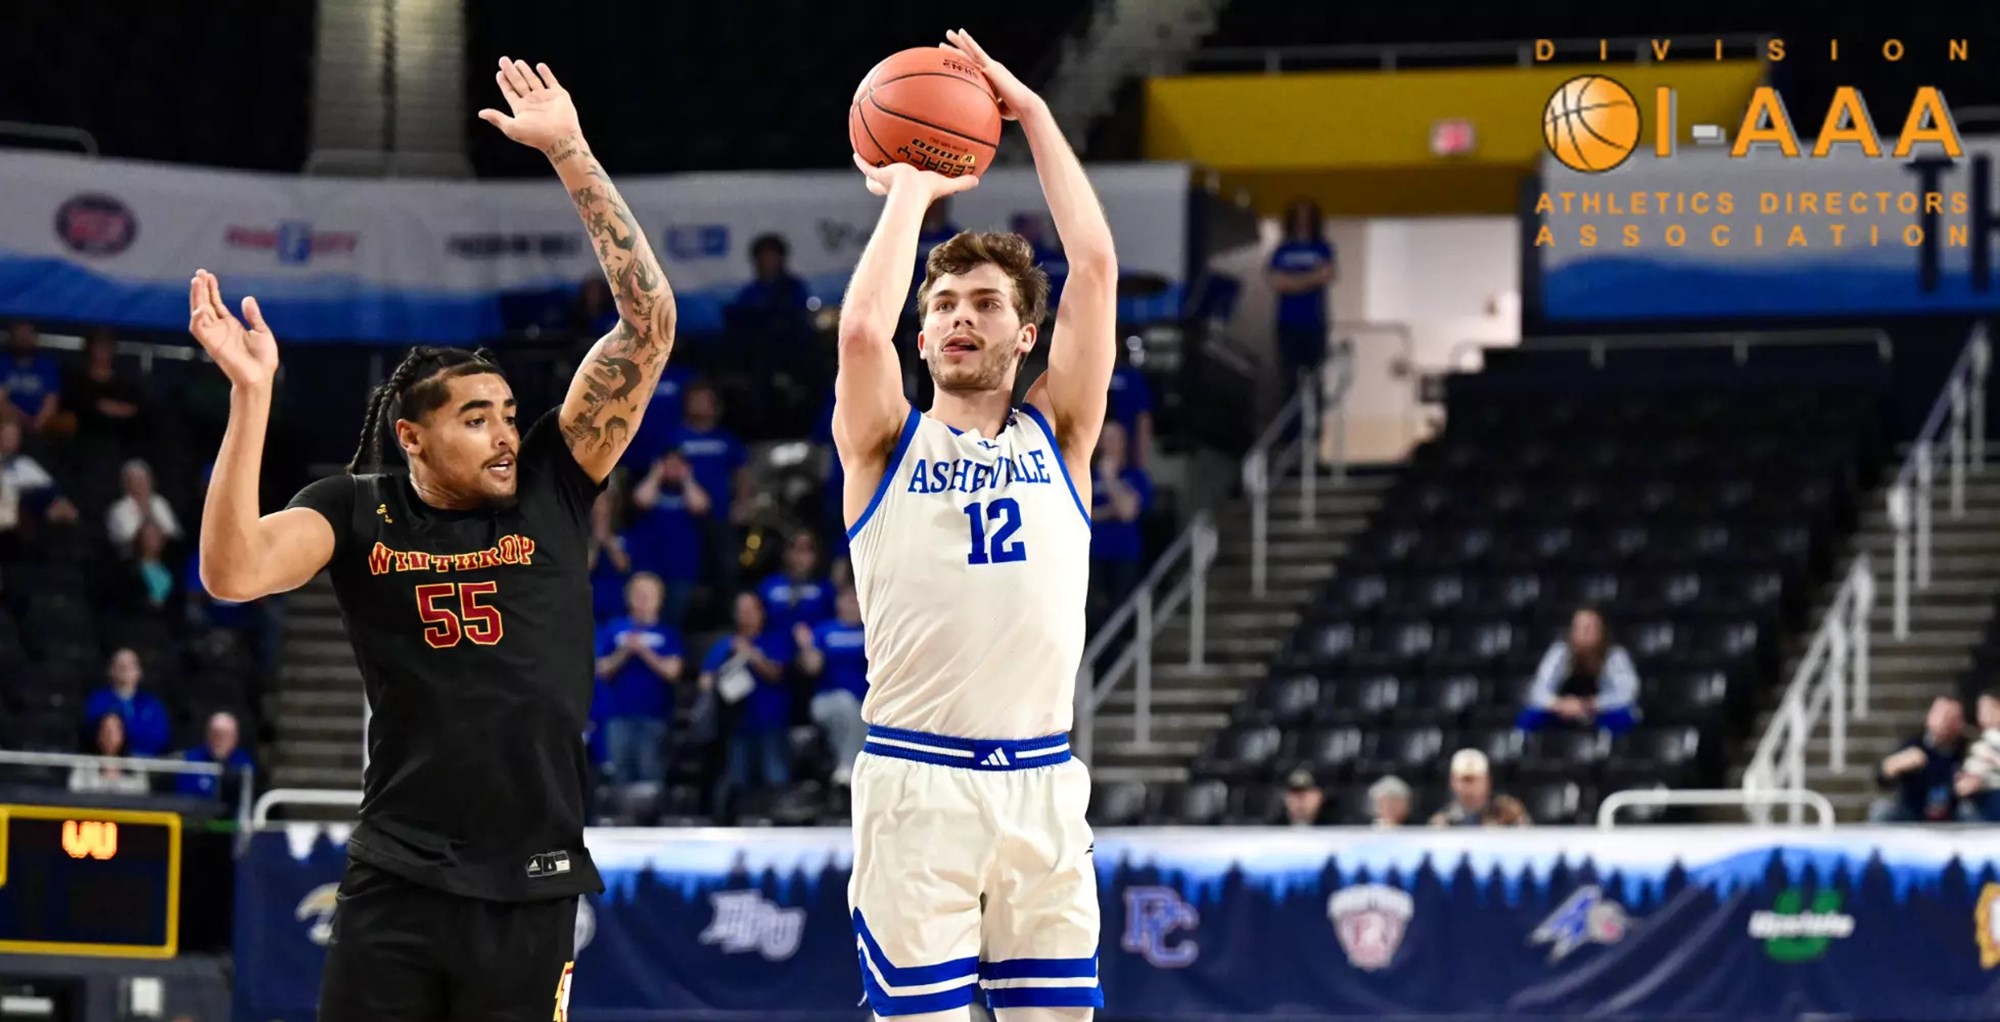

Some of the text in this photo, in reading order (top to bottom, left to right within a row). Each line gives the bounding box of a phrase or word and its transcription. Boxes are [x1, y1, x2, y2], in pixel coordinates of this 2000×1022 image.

[907, 449, 1051, 494] ASHEVILLE
[368, 534, 536, 576] WINTHROP
[963, 497, 1027, 565] 12
[415, 581, 504, 649] 55
